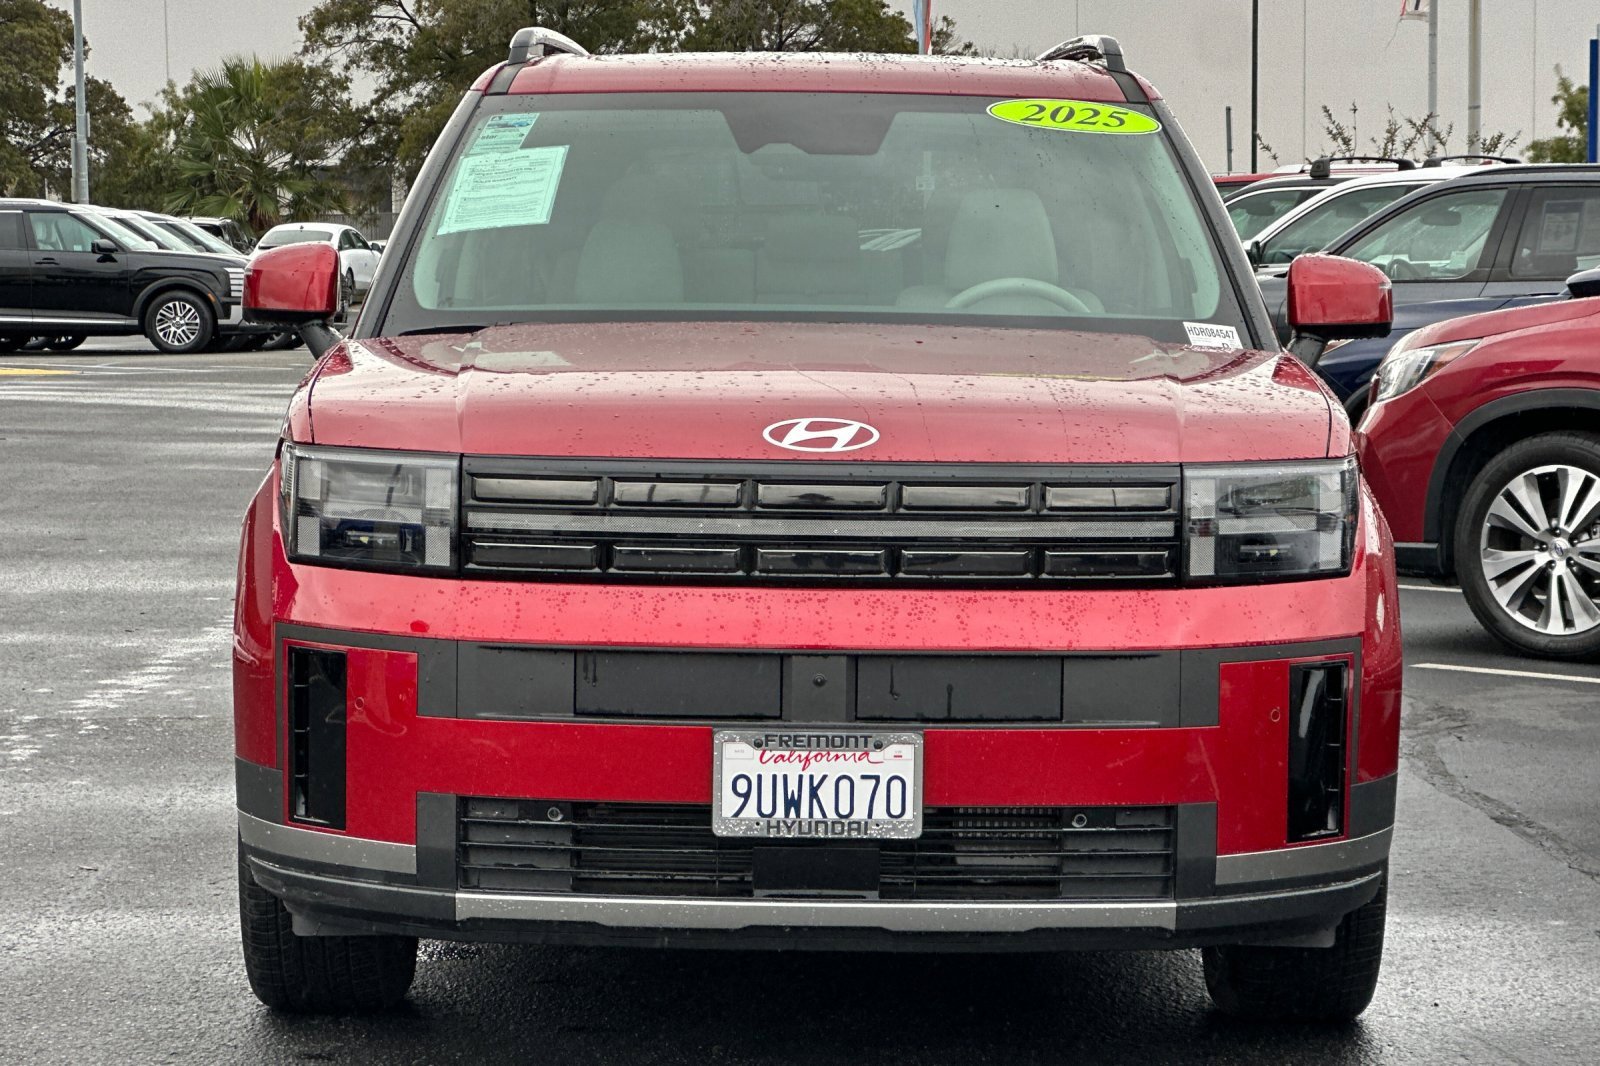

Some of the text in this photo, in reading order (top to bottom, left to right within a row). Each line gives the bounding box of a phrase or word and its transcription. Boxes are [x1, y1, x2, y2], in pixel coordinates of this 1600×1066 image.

[1020, 104, 1129, 128] 2025
[764, 734, 872, 749] FREMONT
[759, 750, 884, 771] California
[731, 773, 907, 819] 9UWK070
[766, 820, 869, 835] HYUNDAI
